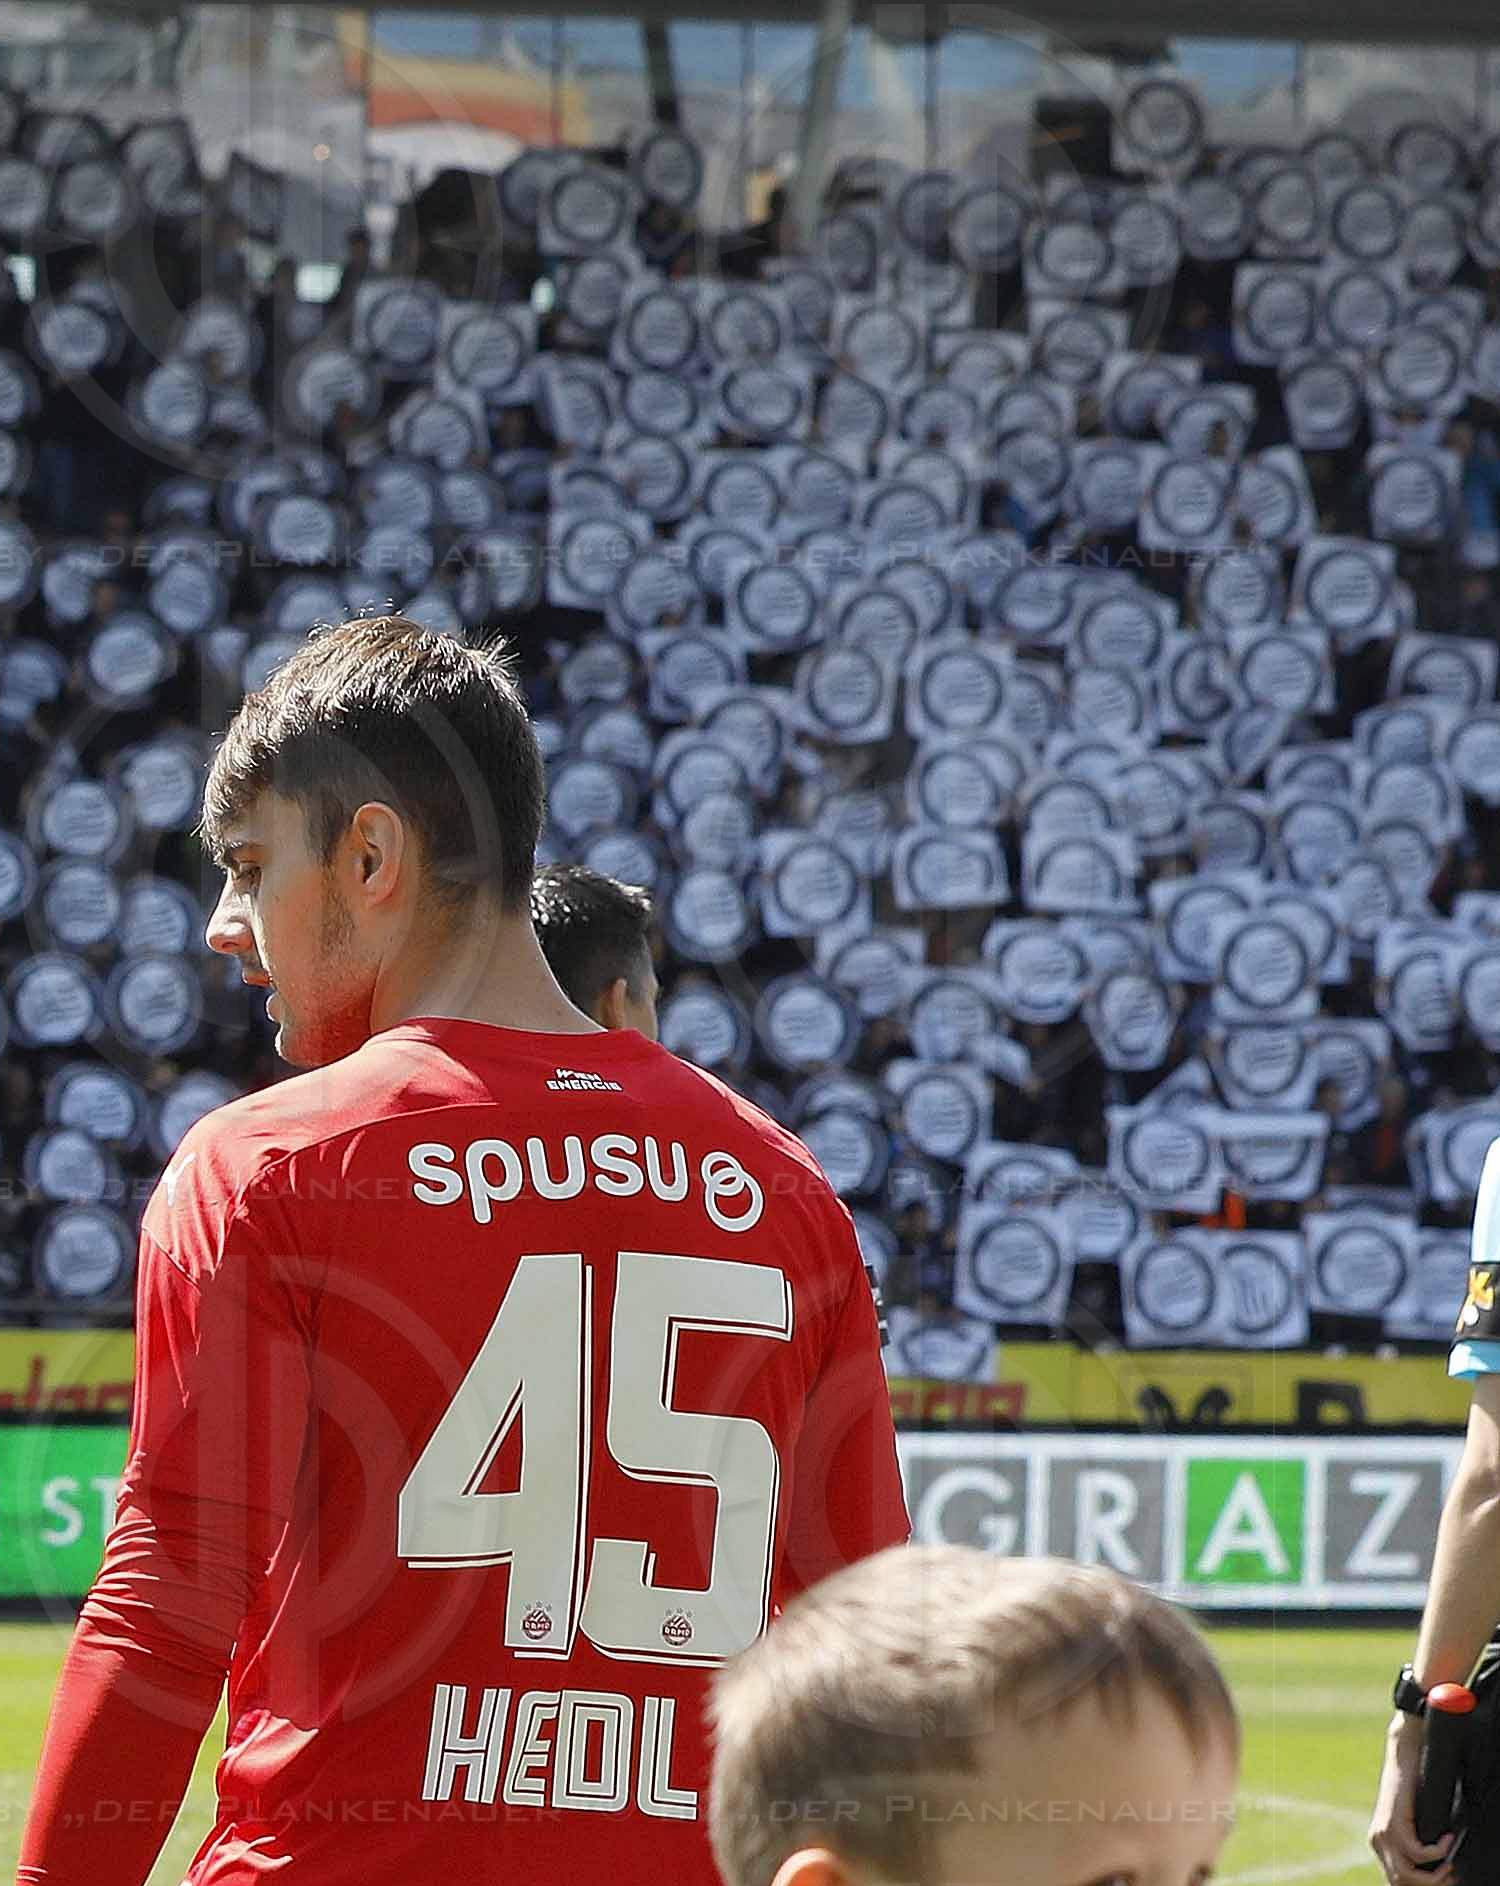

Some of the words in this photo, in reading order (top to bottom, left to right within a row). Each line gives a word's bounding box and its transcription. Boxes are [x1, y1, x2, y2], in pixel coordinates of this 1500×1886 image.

[408, 1134, 689, 1224] spusu
[398, 1251, 792, 1667] 45
[917, 1466, 1422, 1576] GRAZ
[421, 1683, 698, 1820] HEDL
